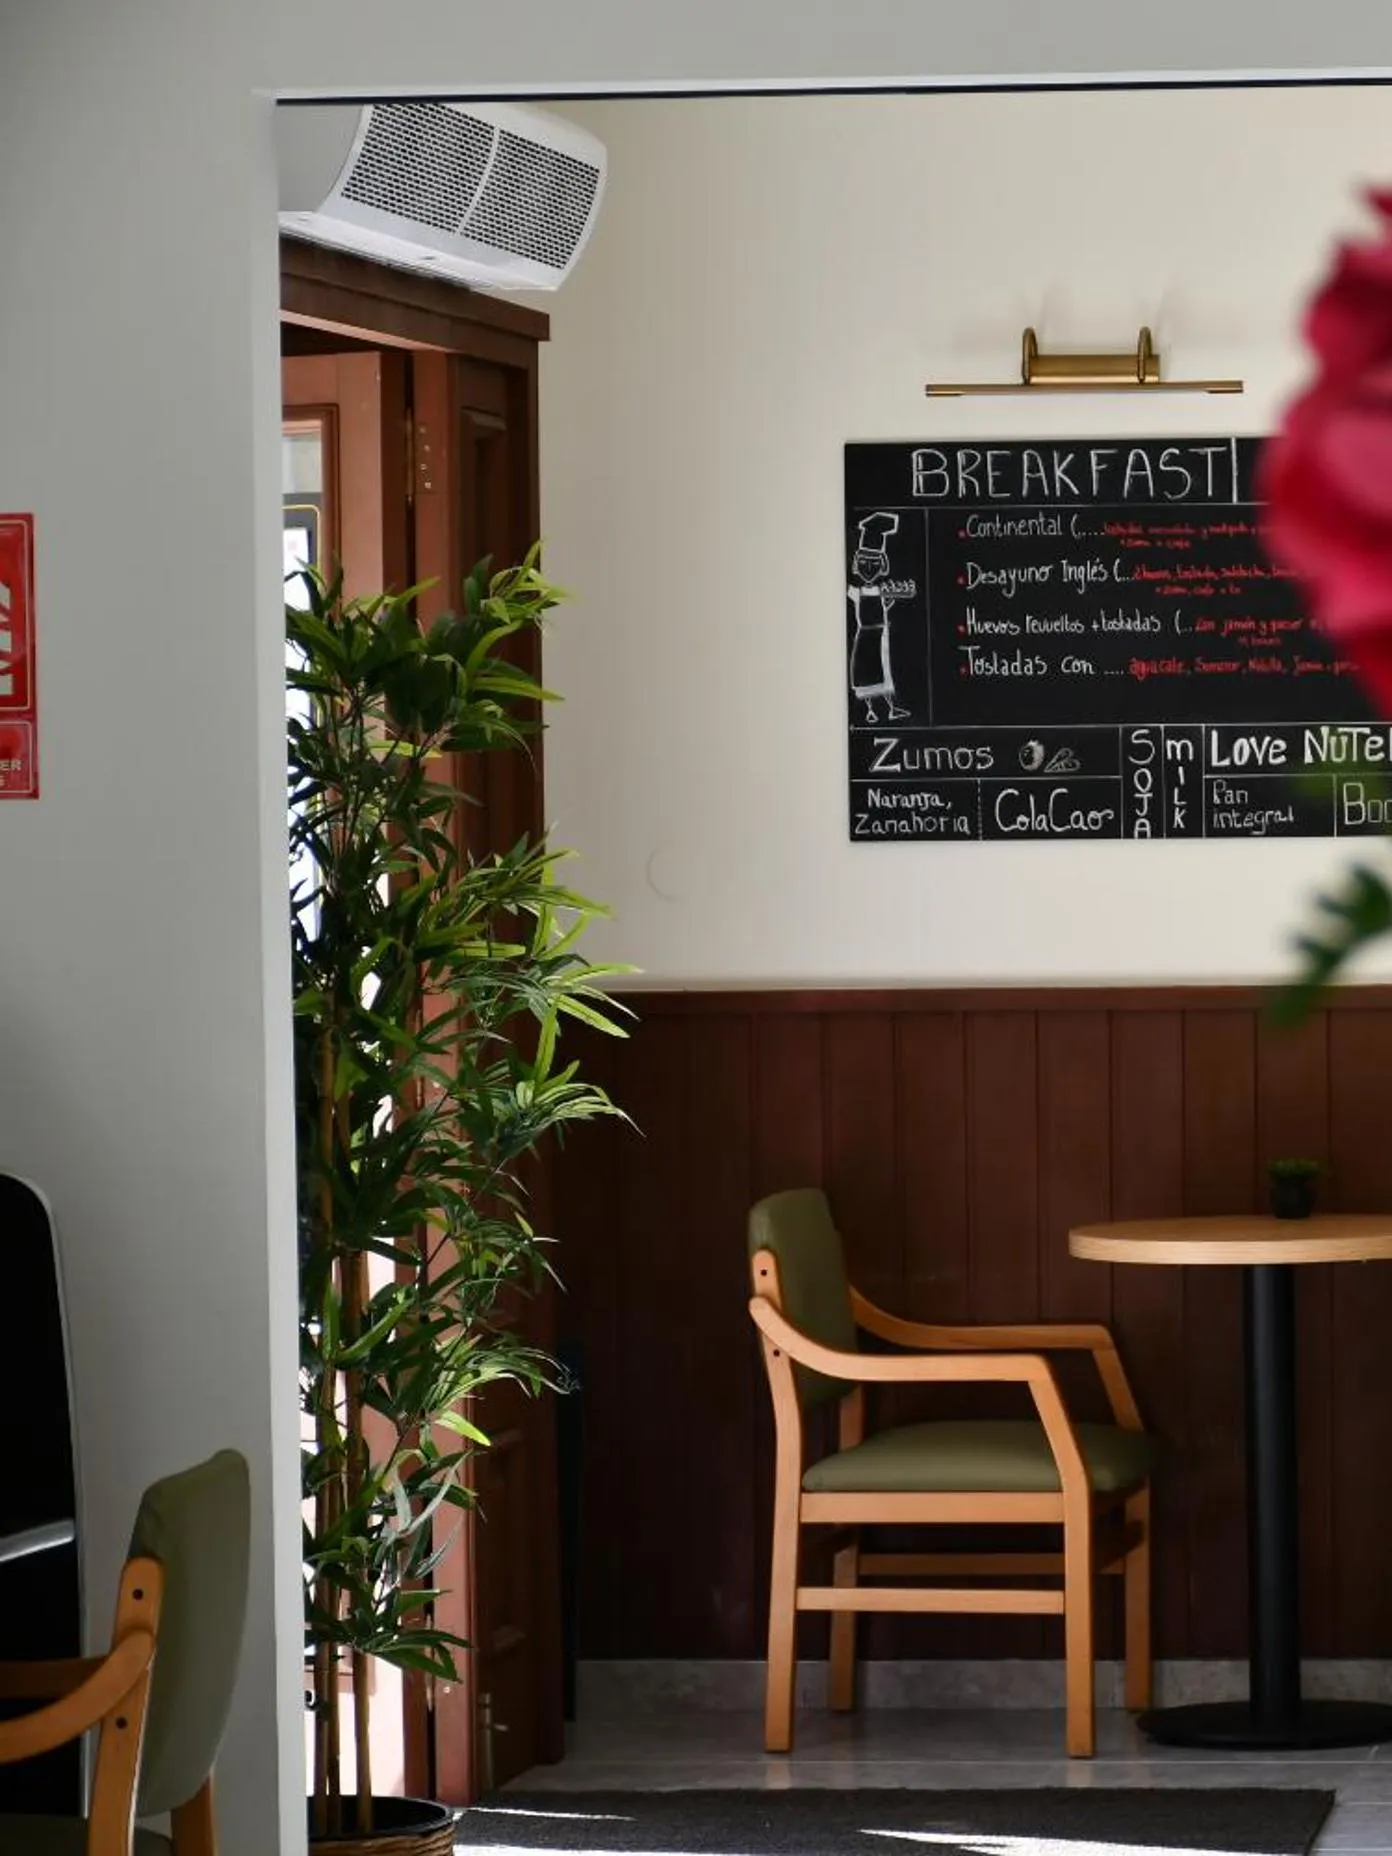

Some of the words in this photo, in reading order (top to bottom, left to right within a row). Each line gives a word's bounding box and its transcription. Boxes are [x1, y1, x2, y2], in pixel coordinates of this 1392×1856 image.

[911, 447, 1228, 498] BREAKFAST
[966, 510, 1063, 538] Continental
[966, 562, 1053, 599] Desayuno
[1061, 557, 1108, 594] Inglés
[966, 605, 1020, 636] Huevos
[958, 645, 1048, 676] Tostadas
[868, 737, 995, 773] Zumos
[1213, 779, 1248, 804] Pan
[855, 811, 971, 835] Zanahoria
